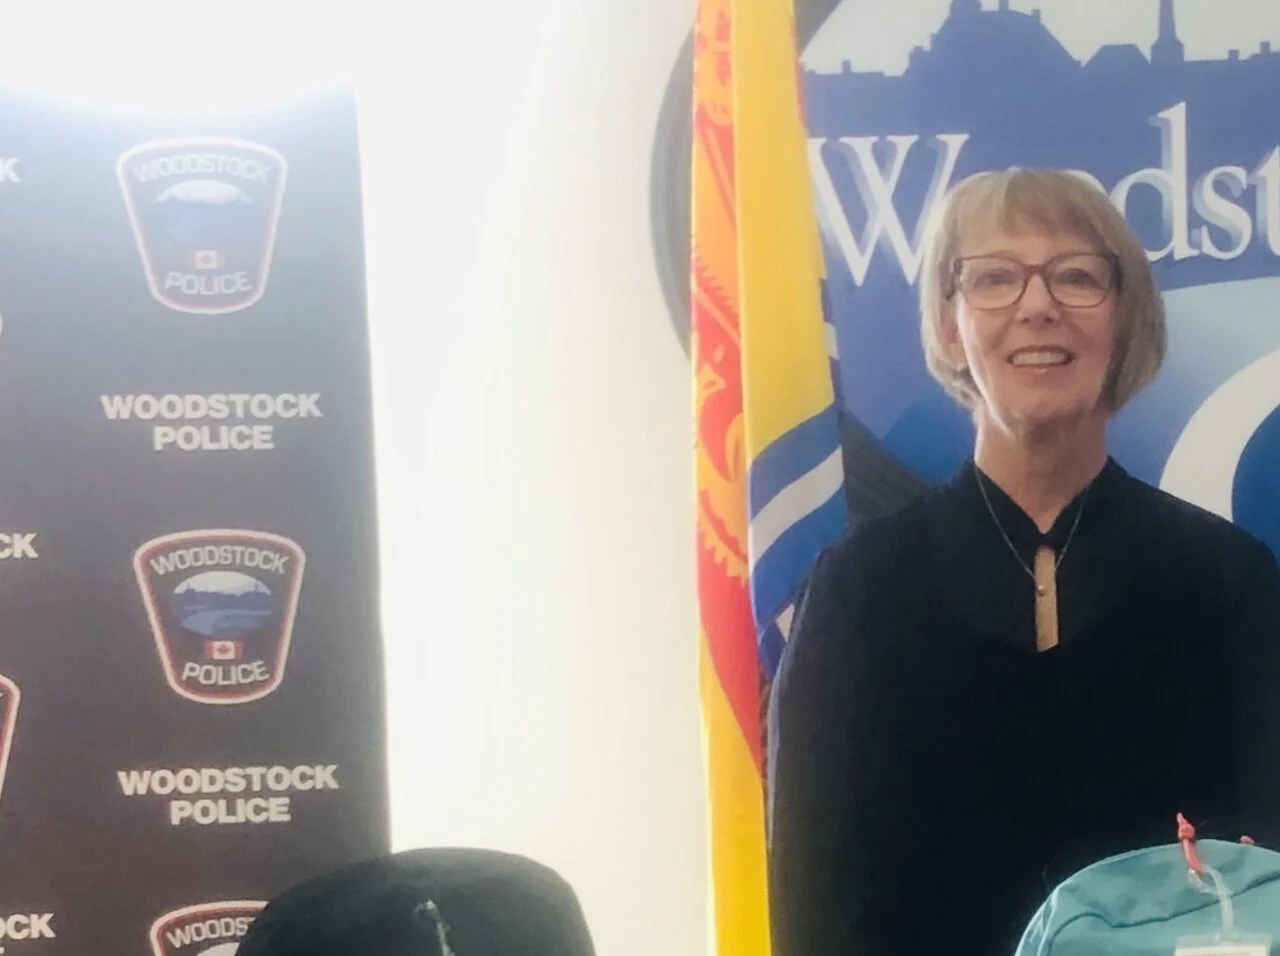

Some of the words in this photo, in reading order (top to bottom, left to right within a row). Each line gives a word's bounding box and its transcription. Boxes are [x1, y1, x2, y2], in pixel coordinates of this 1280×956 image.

[133, 153, 272, 184] WOODSTOCK
[164, 271, 252, 295] POLICE
[101, 393, 323, 420] WOODSTOCK
[154, 424, 274, 450] POLICE
[150, 547, 290, 576] WOODSTOCK
[182, 660, 270, 685] POLICE
[117, 764, 339, 796] WOODSTOCK
[170, 797, 291, 825] POLICE
[166, 916, 257, 949] WOODS
